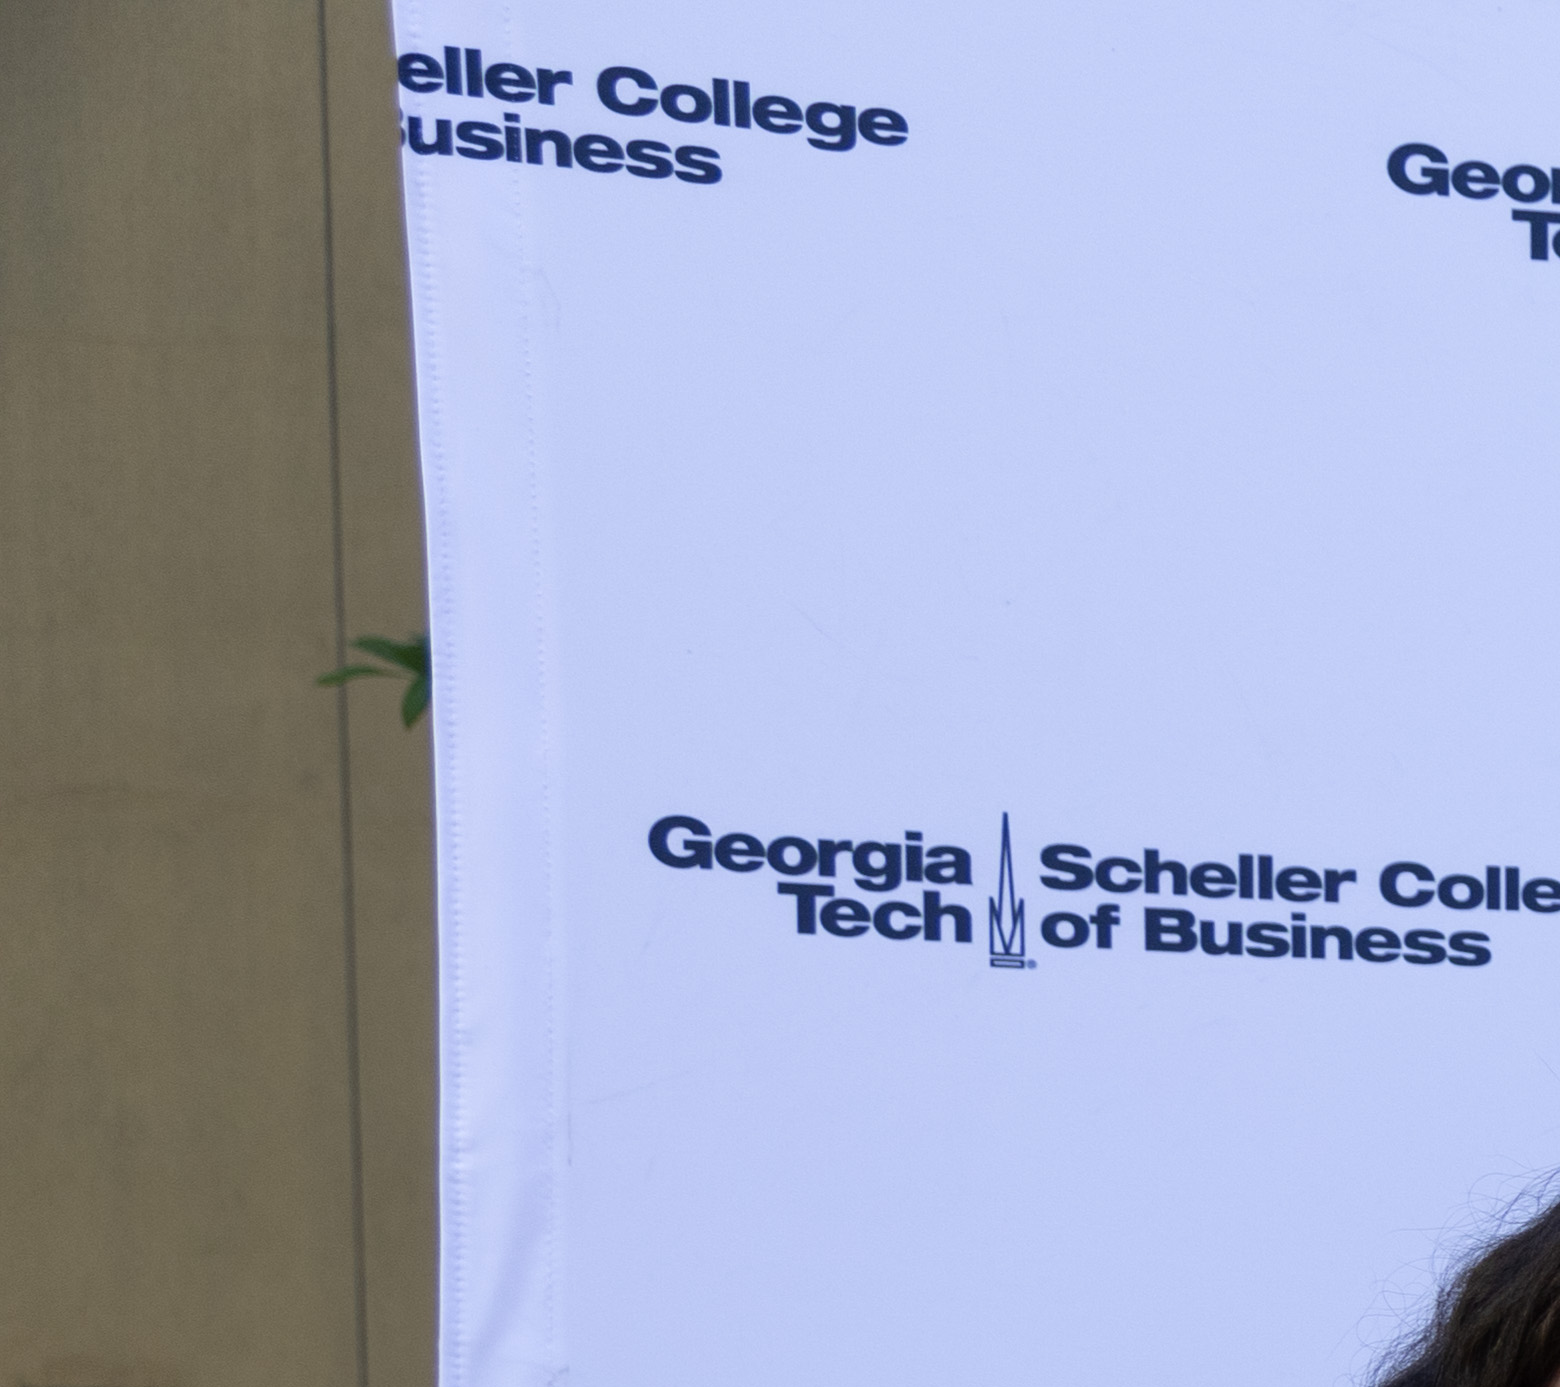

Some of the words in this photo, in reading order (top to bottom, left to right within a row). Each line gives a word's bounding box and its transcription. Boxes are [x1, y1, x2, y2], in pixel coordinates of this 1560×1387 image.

[597, 67, 907, 151] College
[400, 107, 722, 184] usiness
[649, 816, 972, 892] Georgia
[1041, 844, 1356, 902] Scheller
[778, 882, 971, 942] Tech
[1041, 904, 1119, 948] of
[1145, 908, 1491, 966] Business
